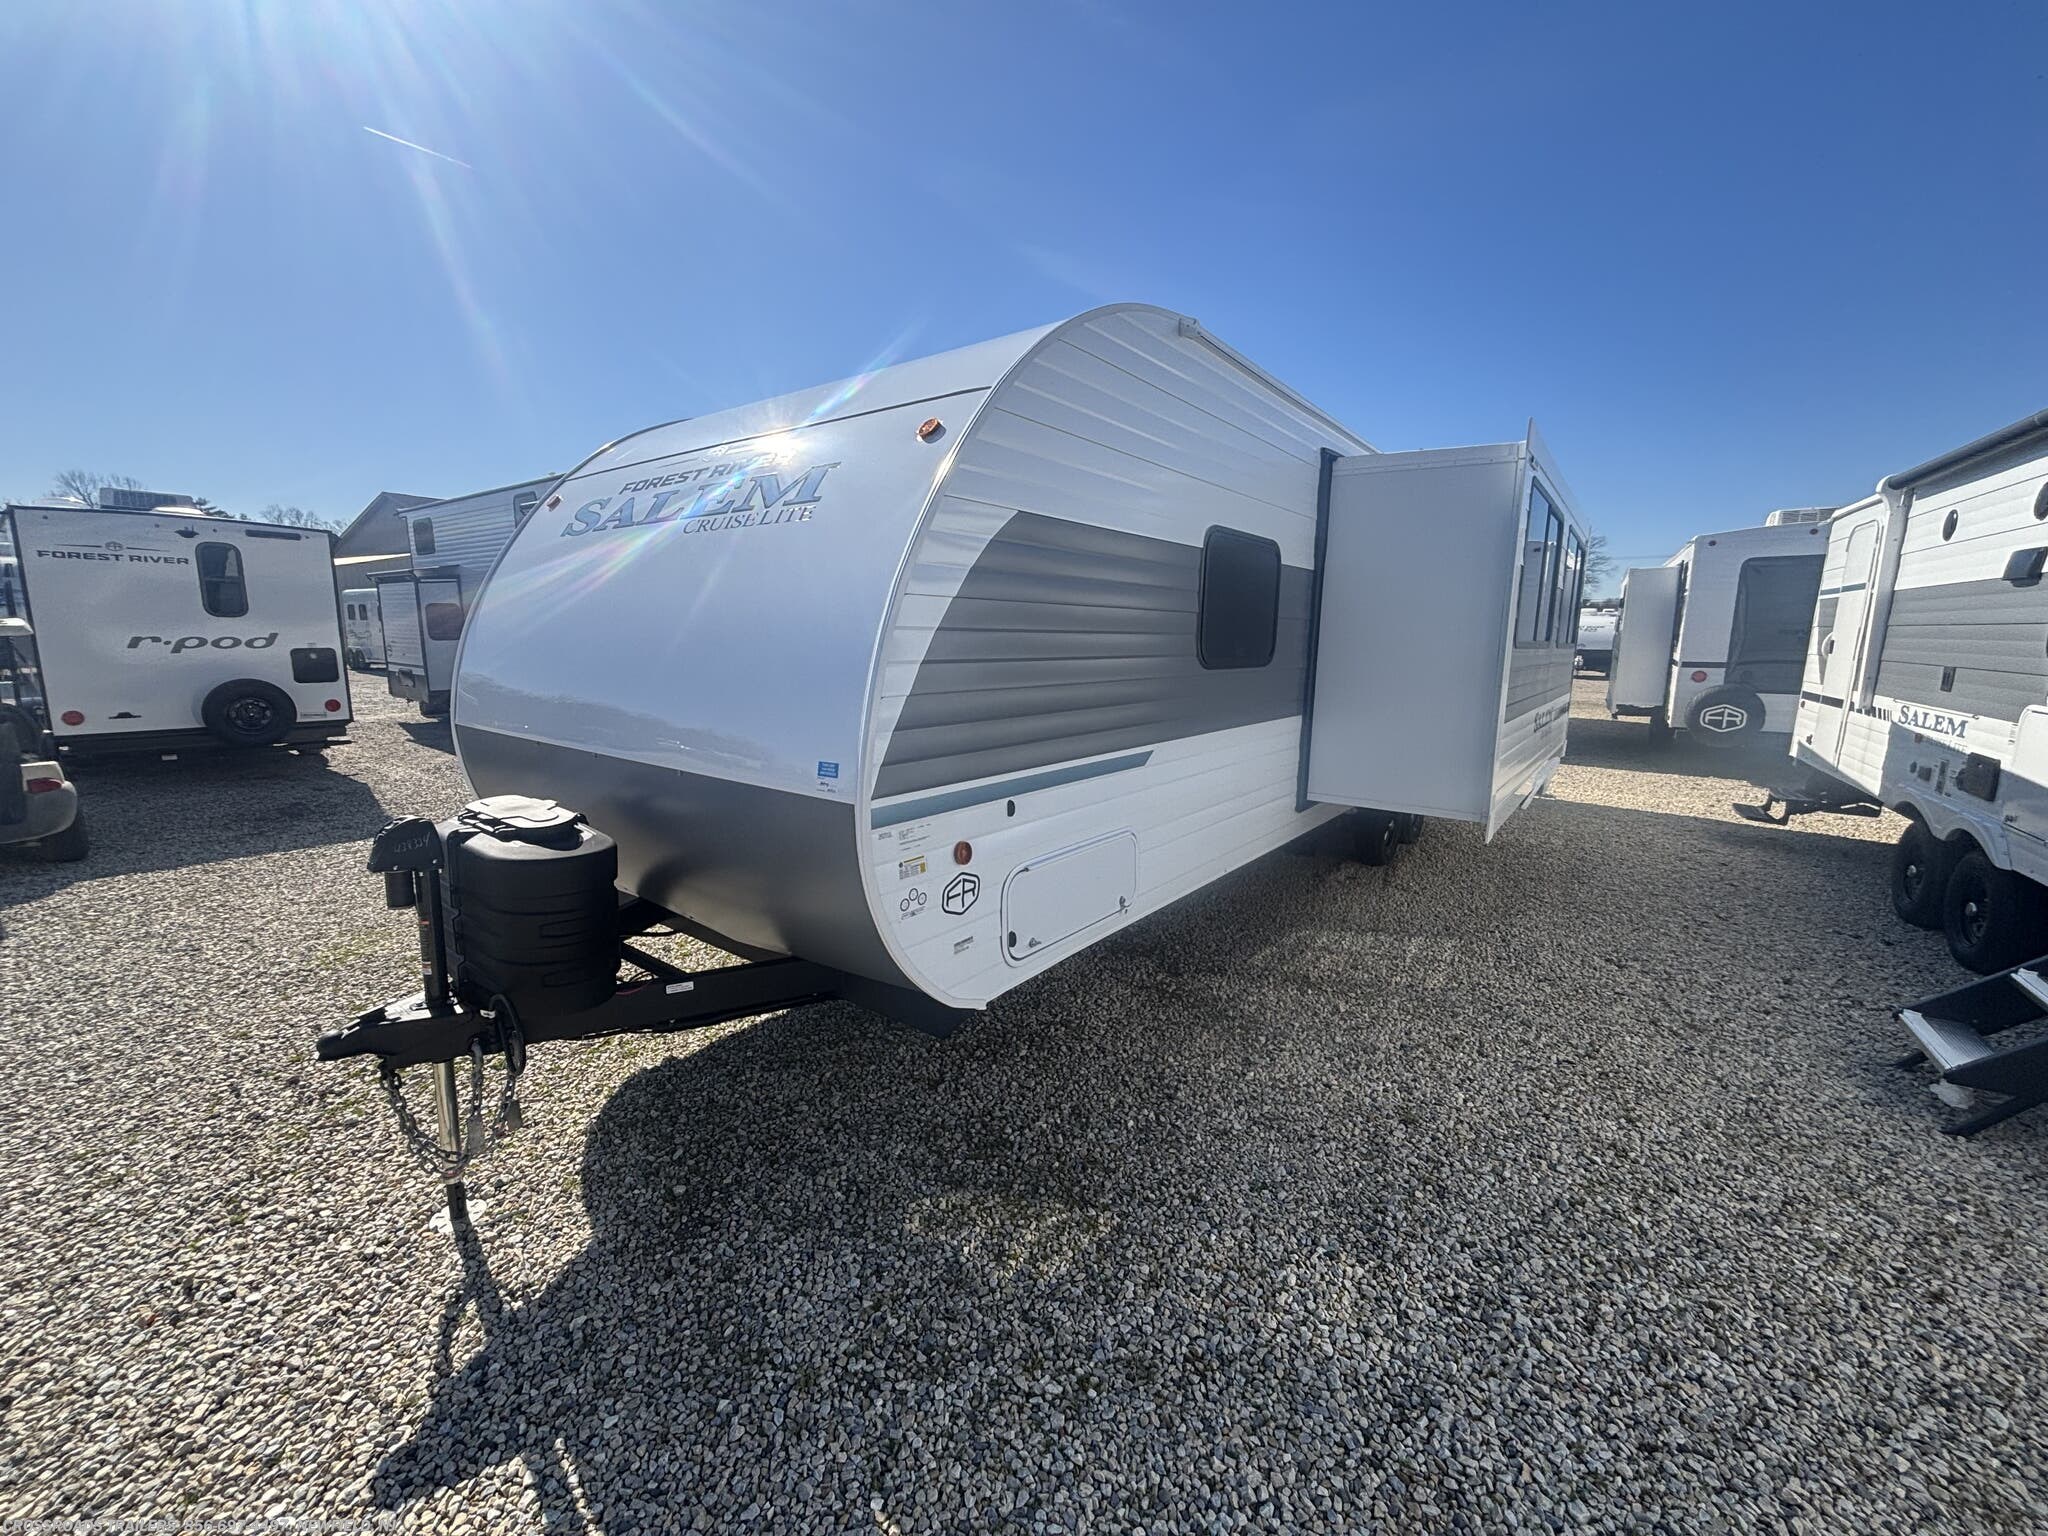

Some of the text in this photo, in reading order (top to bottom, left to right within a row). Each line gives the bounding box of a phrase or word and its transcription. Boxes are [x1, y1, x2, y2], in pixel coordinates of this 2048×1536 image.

[618, 467, 710, 495] FOREST
[560, 461, 842, 537] SALEM
[36, 549, 190, 565] FOREST RIVER
[1898, 704, 1969, 739] SALEM
